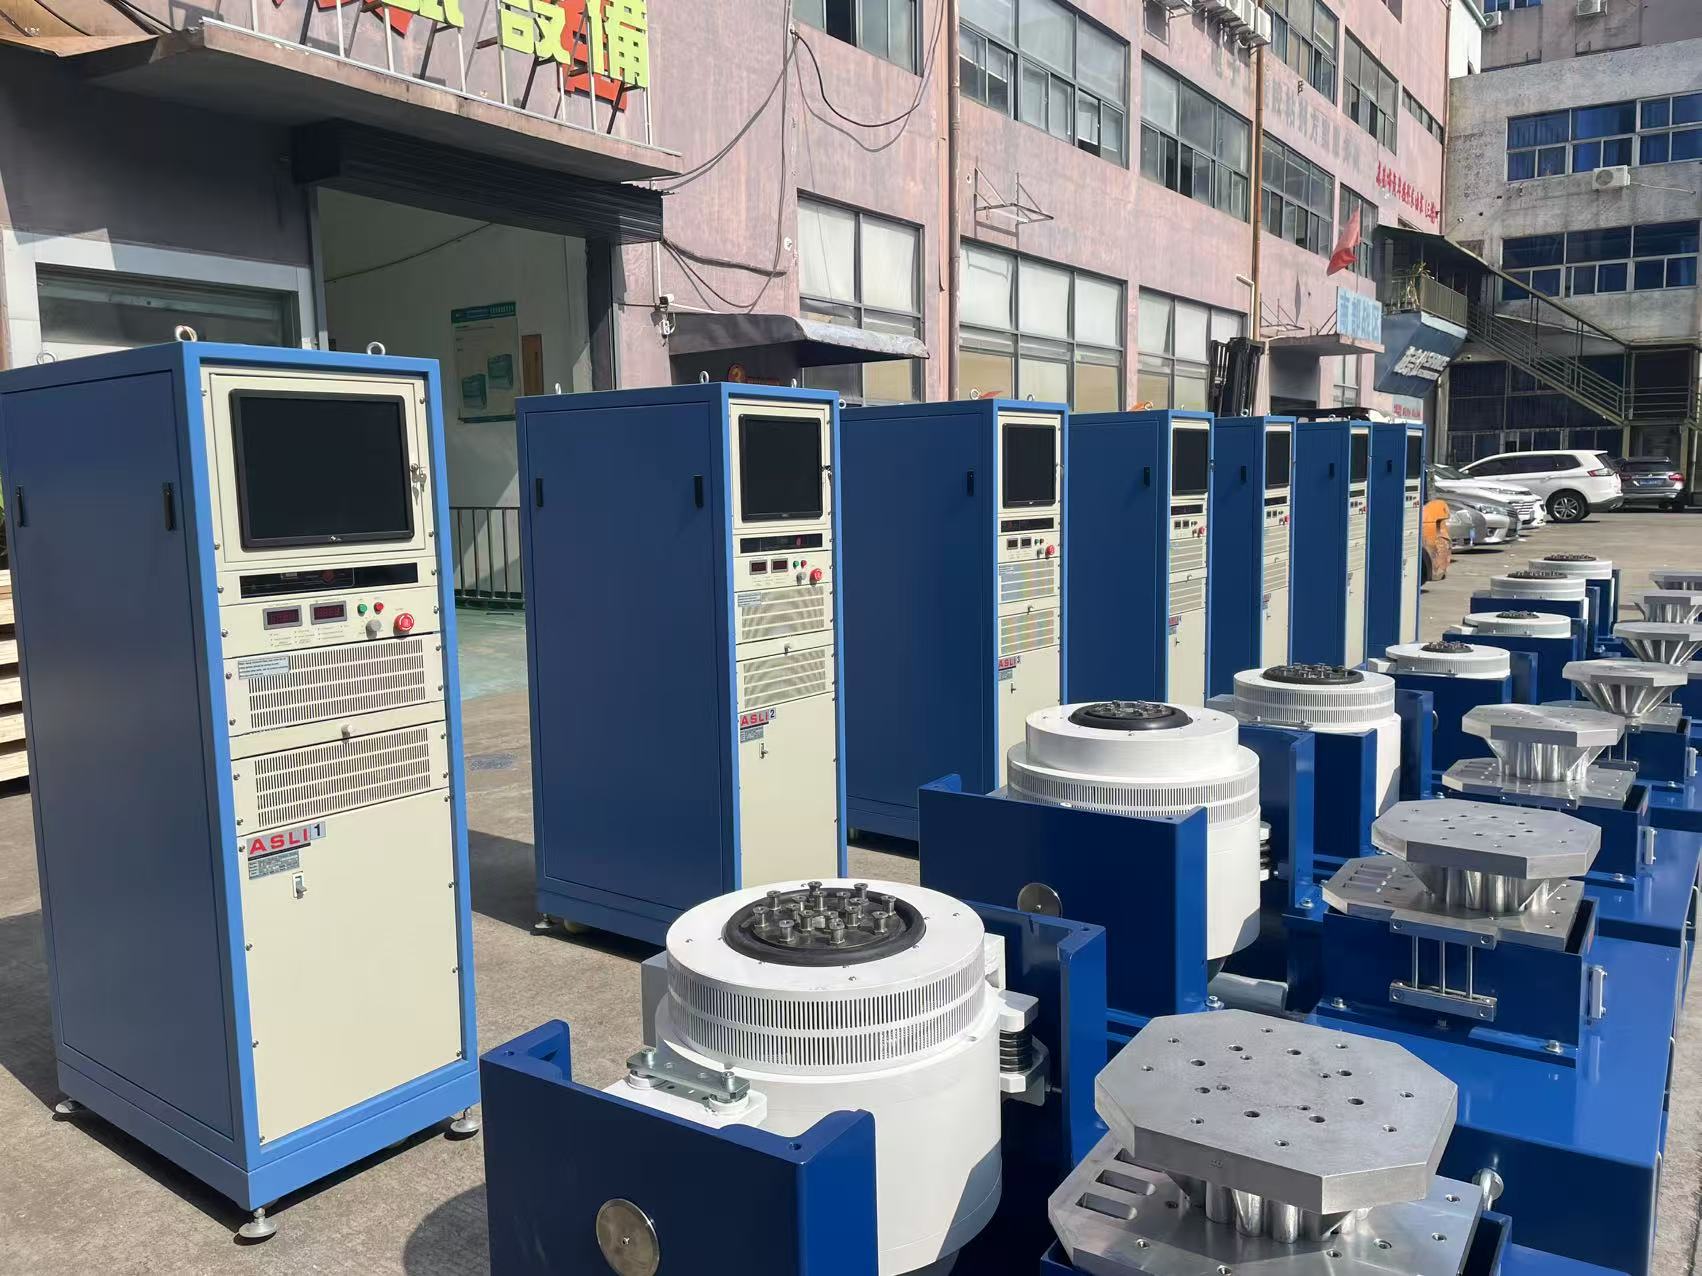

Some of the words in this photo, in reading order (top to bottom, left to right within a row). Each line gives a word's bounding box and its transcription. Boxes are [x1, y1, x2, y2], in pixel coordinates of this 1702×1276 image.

[741, 711, 769, 726] ASLI
[770, 709, 775, 718] 2
[250, 828, 308, 855] ASLI
[314, 823, 321, 837] 1
